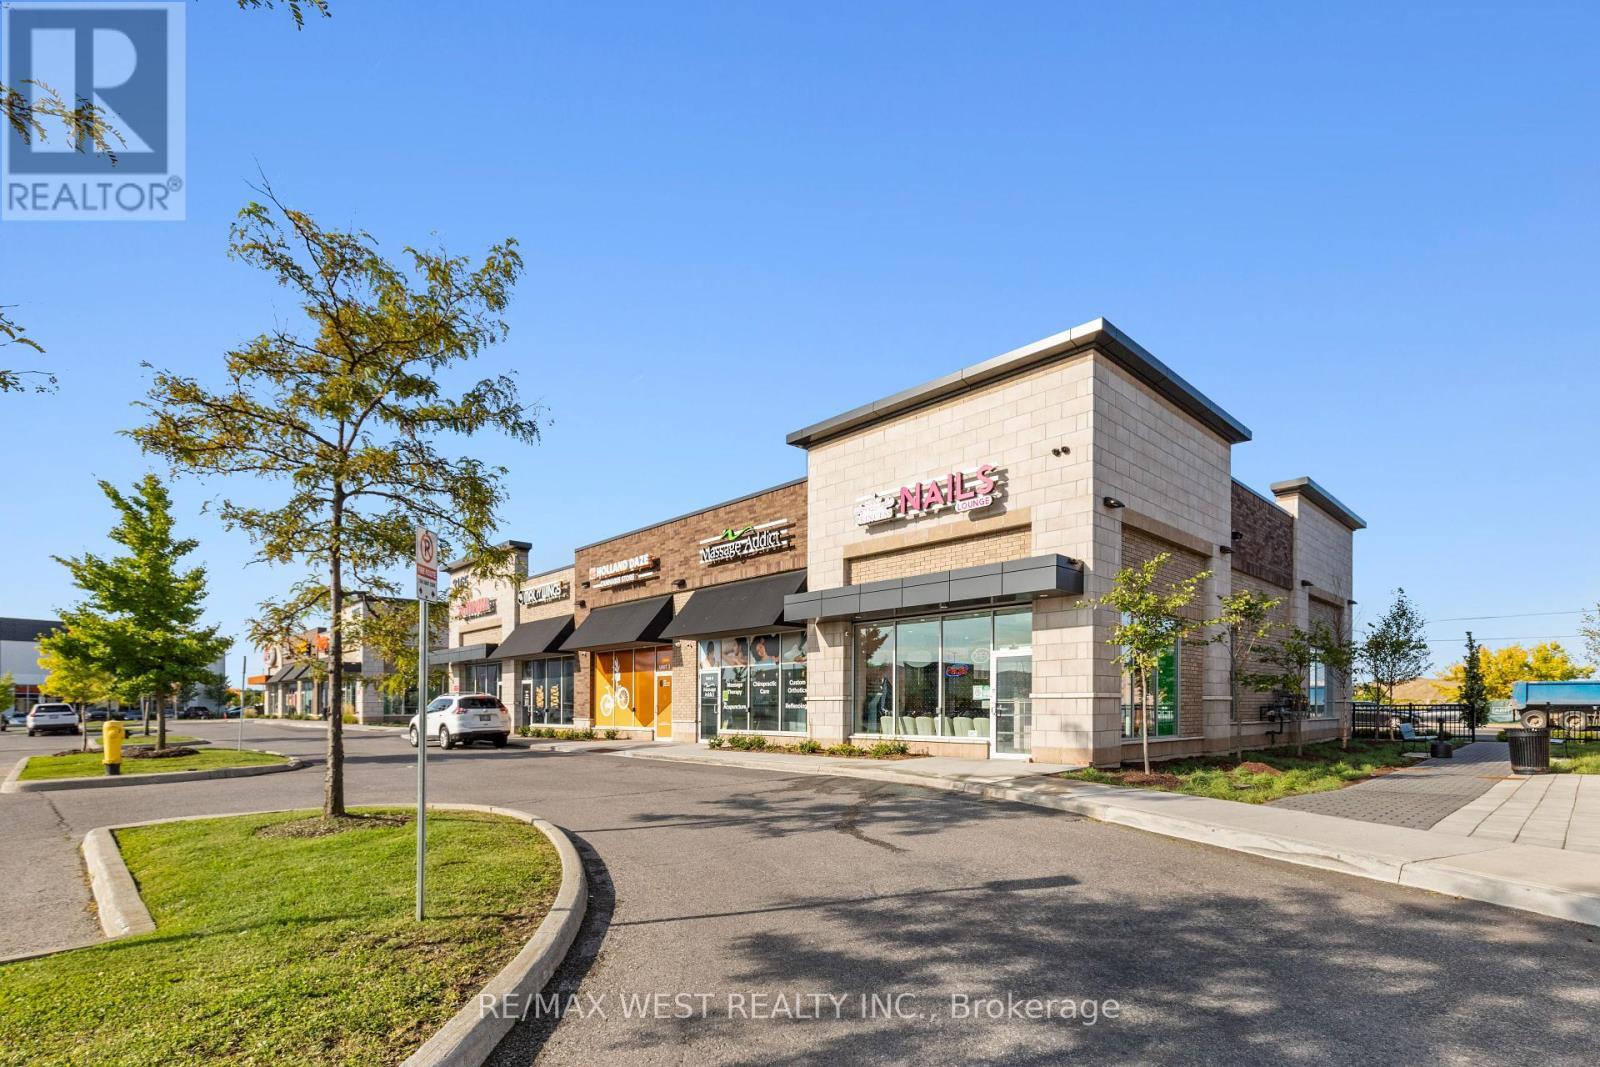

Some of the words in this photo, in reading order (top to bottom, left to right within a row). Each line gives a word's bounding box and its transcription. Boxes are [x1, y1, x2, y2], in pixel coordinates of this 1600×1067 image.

[899, 463, 994, 513] NAILS
[956, 496, 991, 511] LOUNGE
[701, 540, 742, 563] Massage
[743, 529, 780, 553] Addict
[596, 560, 629, 577] HOLLAND
[629, 554, 650, 570] DAZE
[752, 680, 777, 688] Chiropractic
